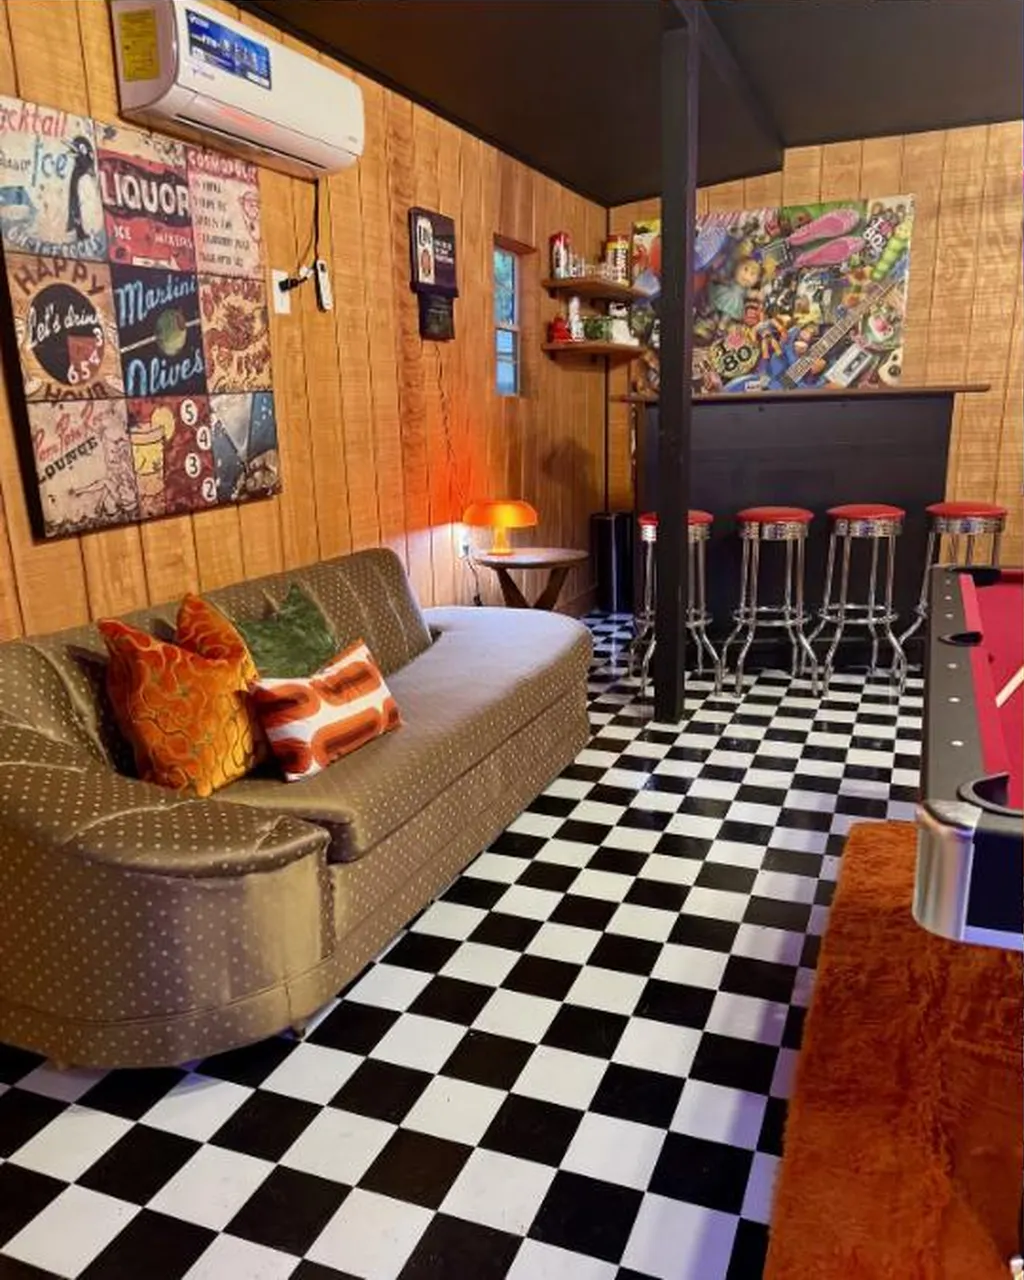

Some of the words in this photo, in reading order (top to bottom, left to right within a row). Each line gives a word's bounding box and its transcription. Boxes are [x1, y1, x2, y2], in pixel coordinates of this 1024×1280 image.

[13, 258, 105, 296] HAPPY
[114, 273, 197, 328] Martini
[92, 326, 103, 347] 3
[67, 362, 79, 384] 6
[80, 360, 91, 380] 5
[126, 347, 206, 397] Olives
[723, 345, 752, 372] 80
